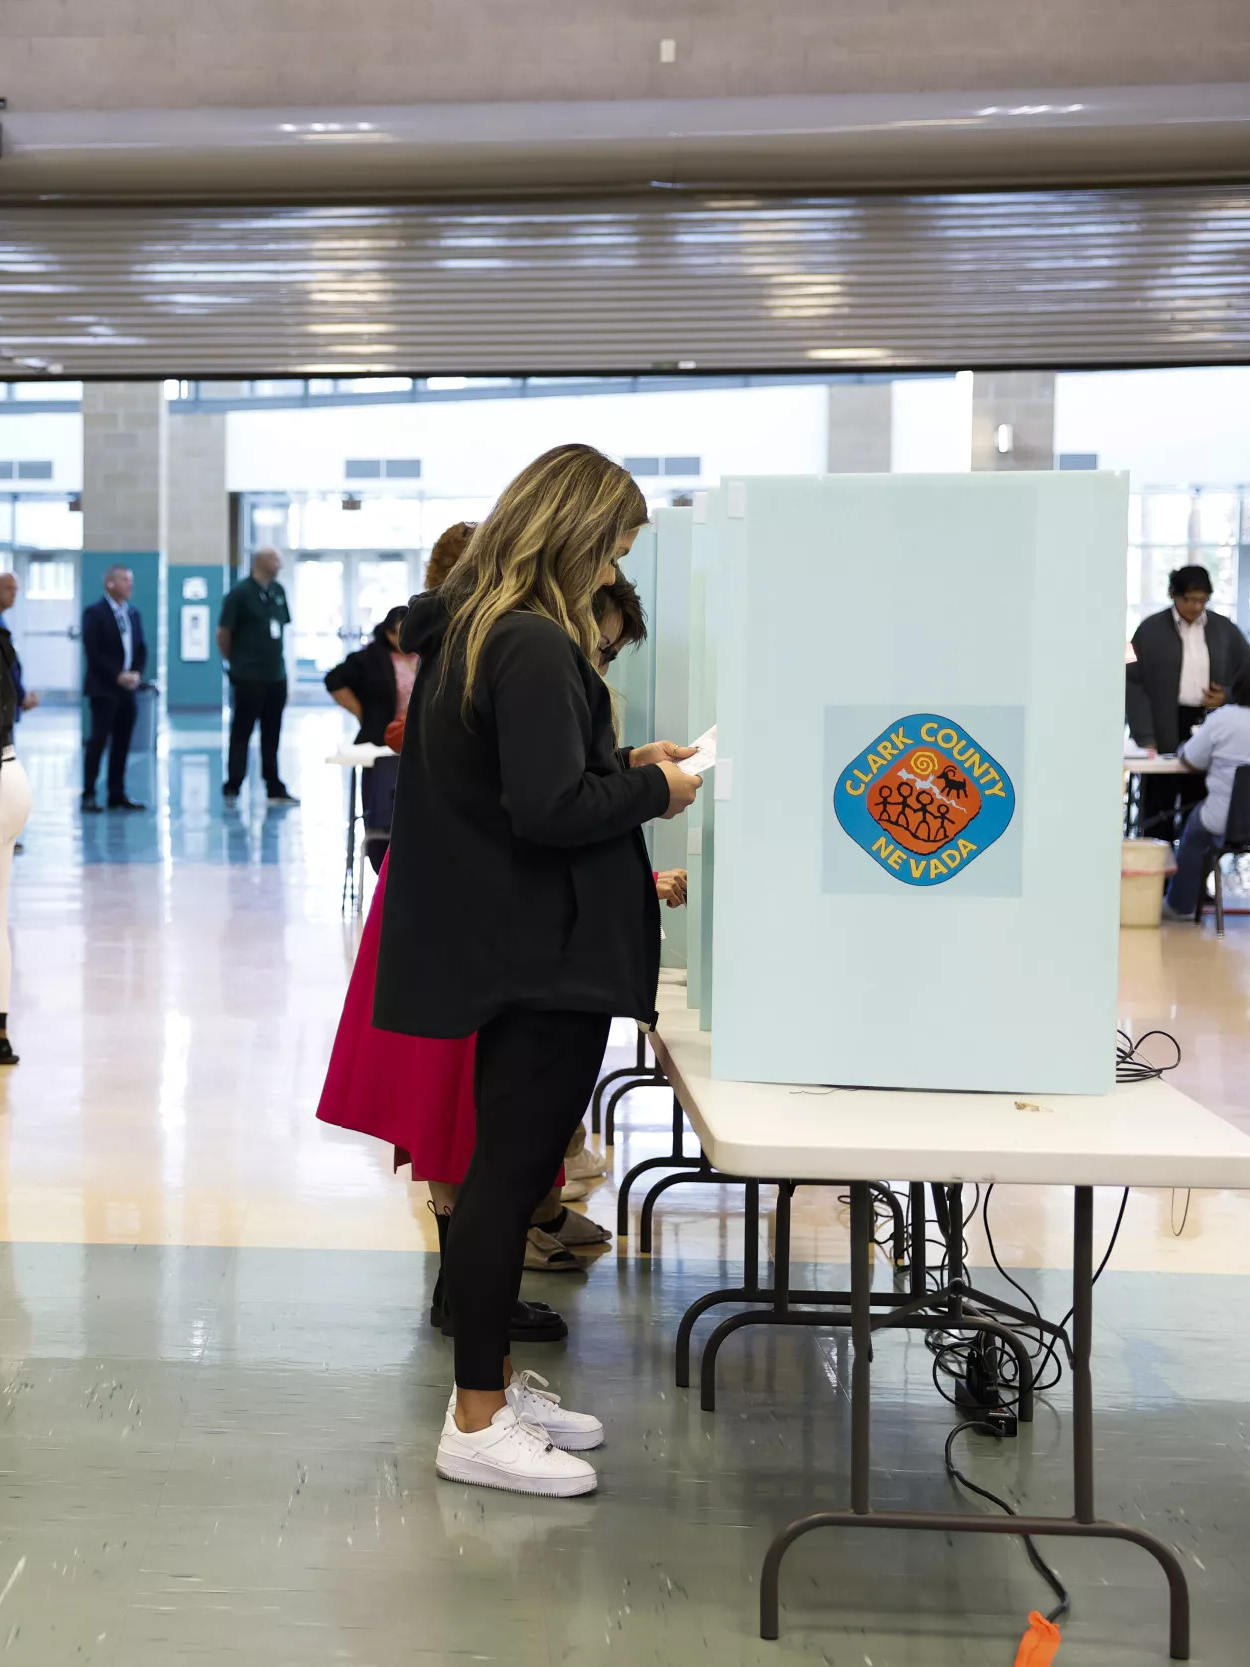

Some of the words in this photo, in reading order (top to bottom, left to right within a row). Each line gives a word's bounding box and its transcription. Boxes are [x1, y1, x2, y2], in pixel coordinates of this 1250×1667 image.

[845, 726, 914, 796] CLARK
[920, 722, 1006, 798] COUNTY
[871, 836, 978, 879] NEVADA
